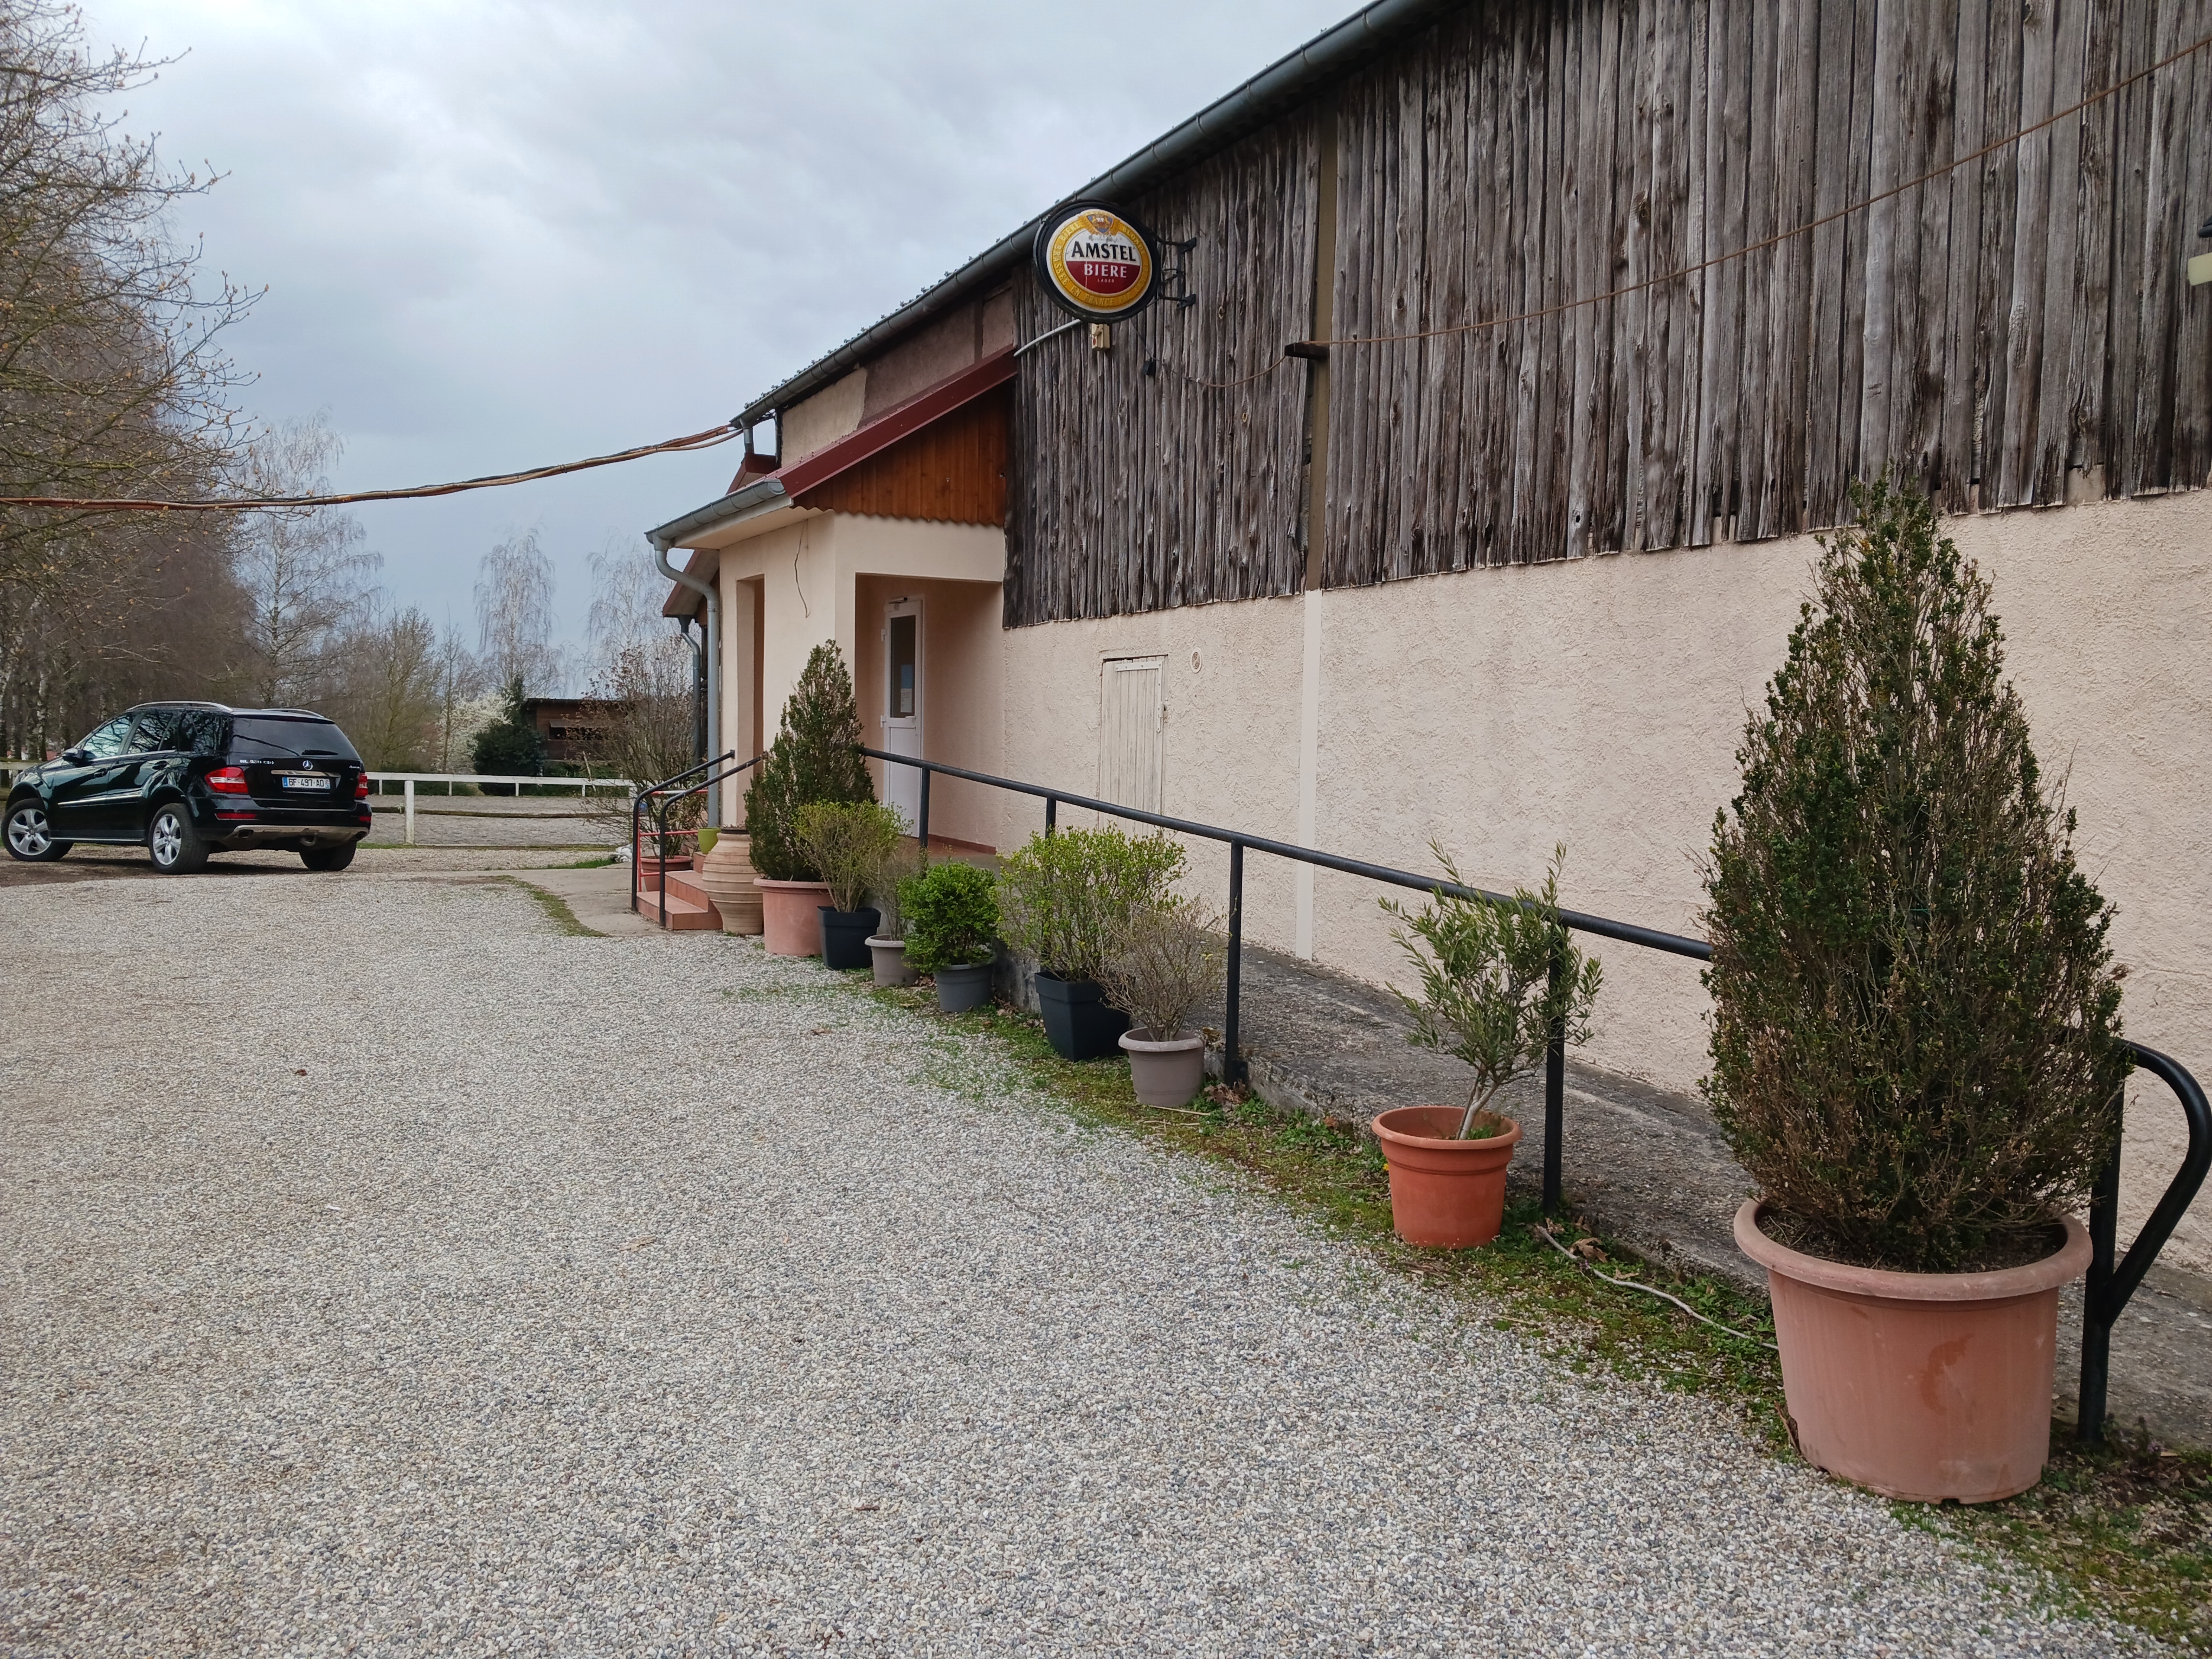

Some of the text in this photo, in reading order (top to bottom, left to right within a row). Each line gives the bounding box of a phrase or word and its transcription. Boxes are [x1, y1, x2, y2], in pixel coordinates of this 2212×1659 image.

[1059, 222, 1082, 240] BIERE
[1071, 241, 1136, 261] AMSTEL
[1084, 263, 1127, 278] BIERE
[1084, 295, 1115, 306] FRANCE
